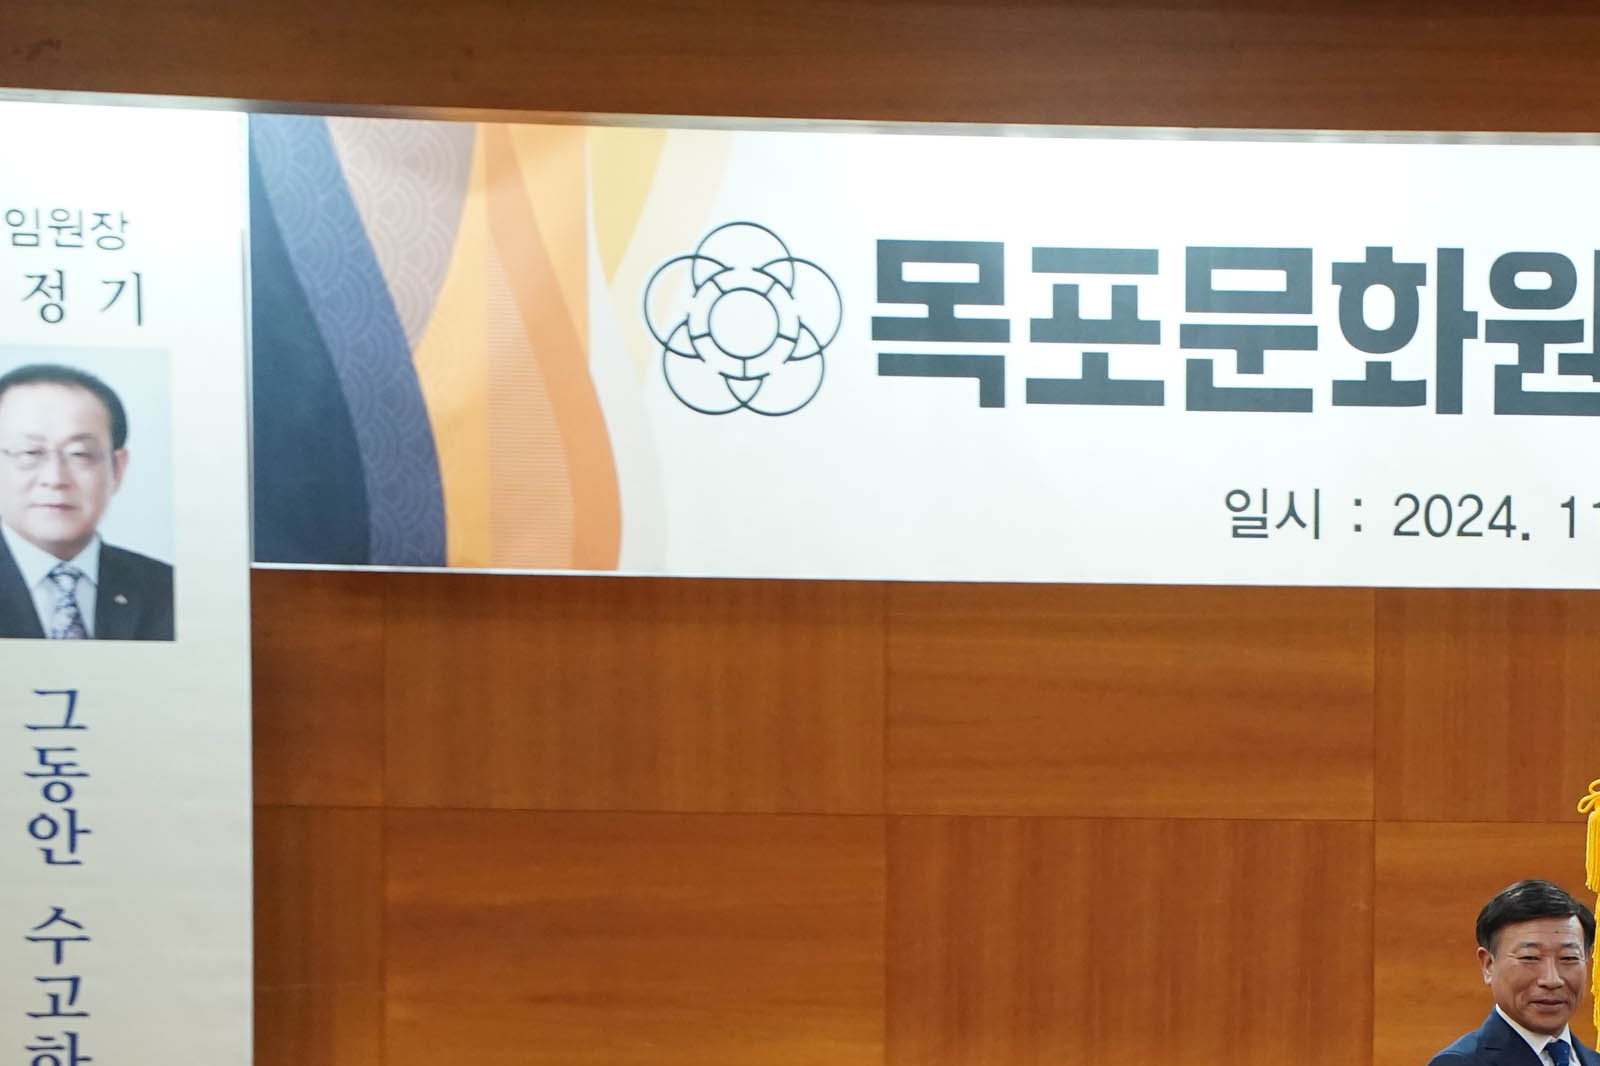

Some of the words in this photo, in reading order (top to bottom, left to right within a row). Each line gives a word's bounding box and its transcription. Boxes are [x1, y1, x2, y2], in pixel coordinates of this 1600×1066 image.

[4, 207, 128, 251] 임원장
[1224, 488, 1321, 540] 일시
[1392, 492, 1531, 542] 2024.
[23, 688, 93, 866] 그동안
